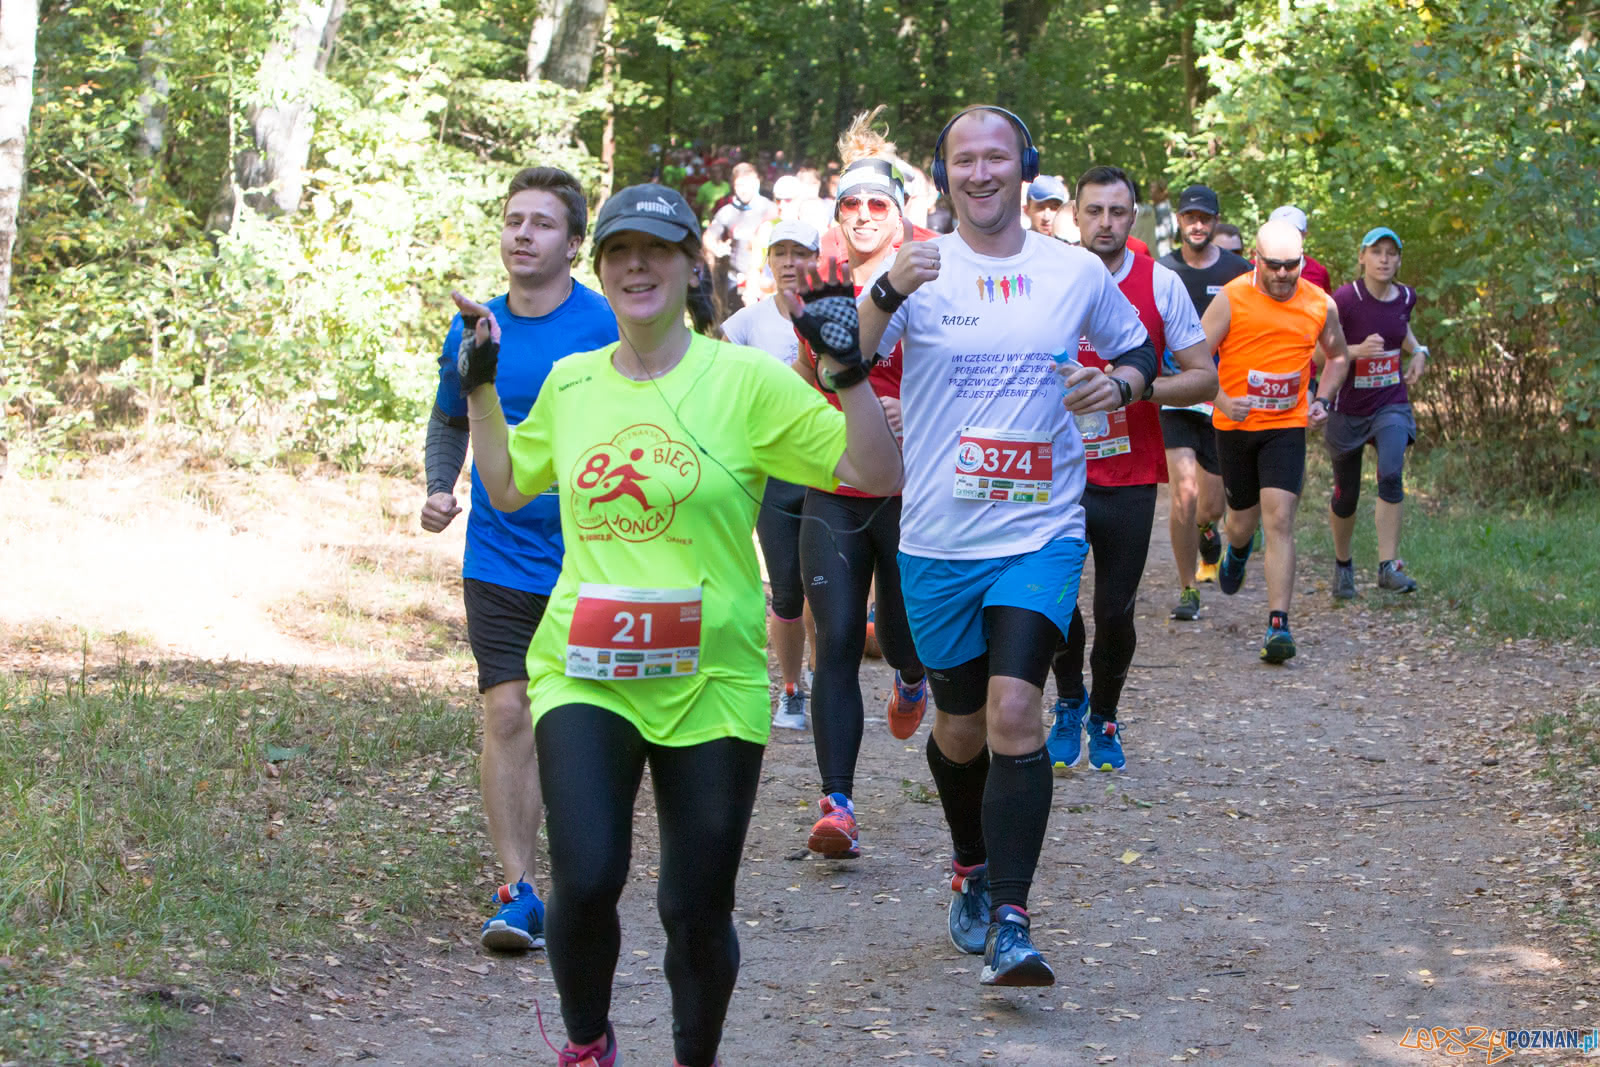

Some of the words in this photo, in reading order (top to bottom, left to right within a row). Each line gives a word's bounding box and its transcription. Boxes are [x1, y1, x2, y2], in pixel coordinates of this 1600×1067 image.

[636, 201, 670, 216] PUMA
[941, 315, 979, 326] RADEK
[952, 355, 963, 363] IM
[1368, 360, 1391, 374] 364
[1261, 382, 1289, 395] 394
[654, 447, 694, 477] BIEG
[983, 447, 1032, 475] 374
[611, 611, 653, 643] 21
